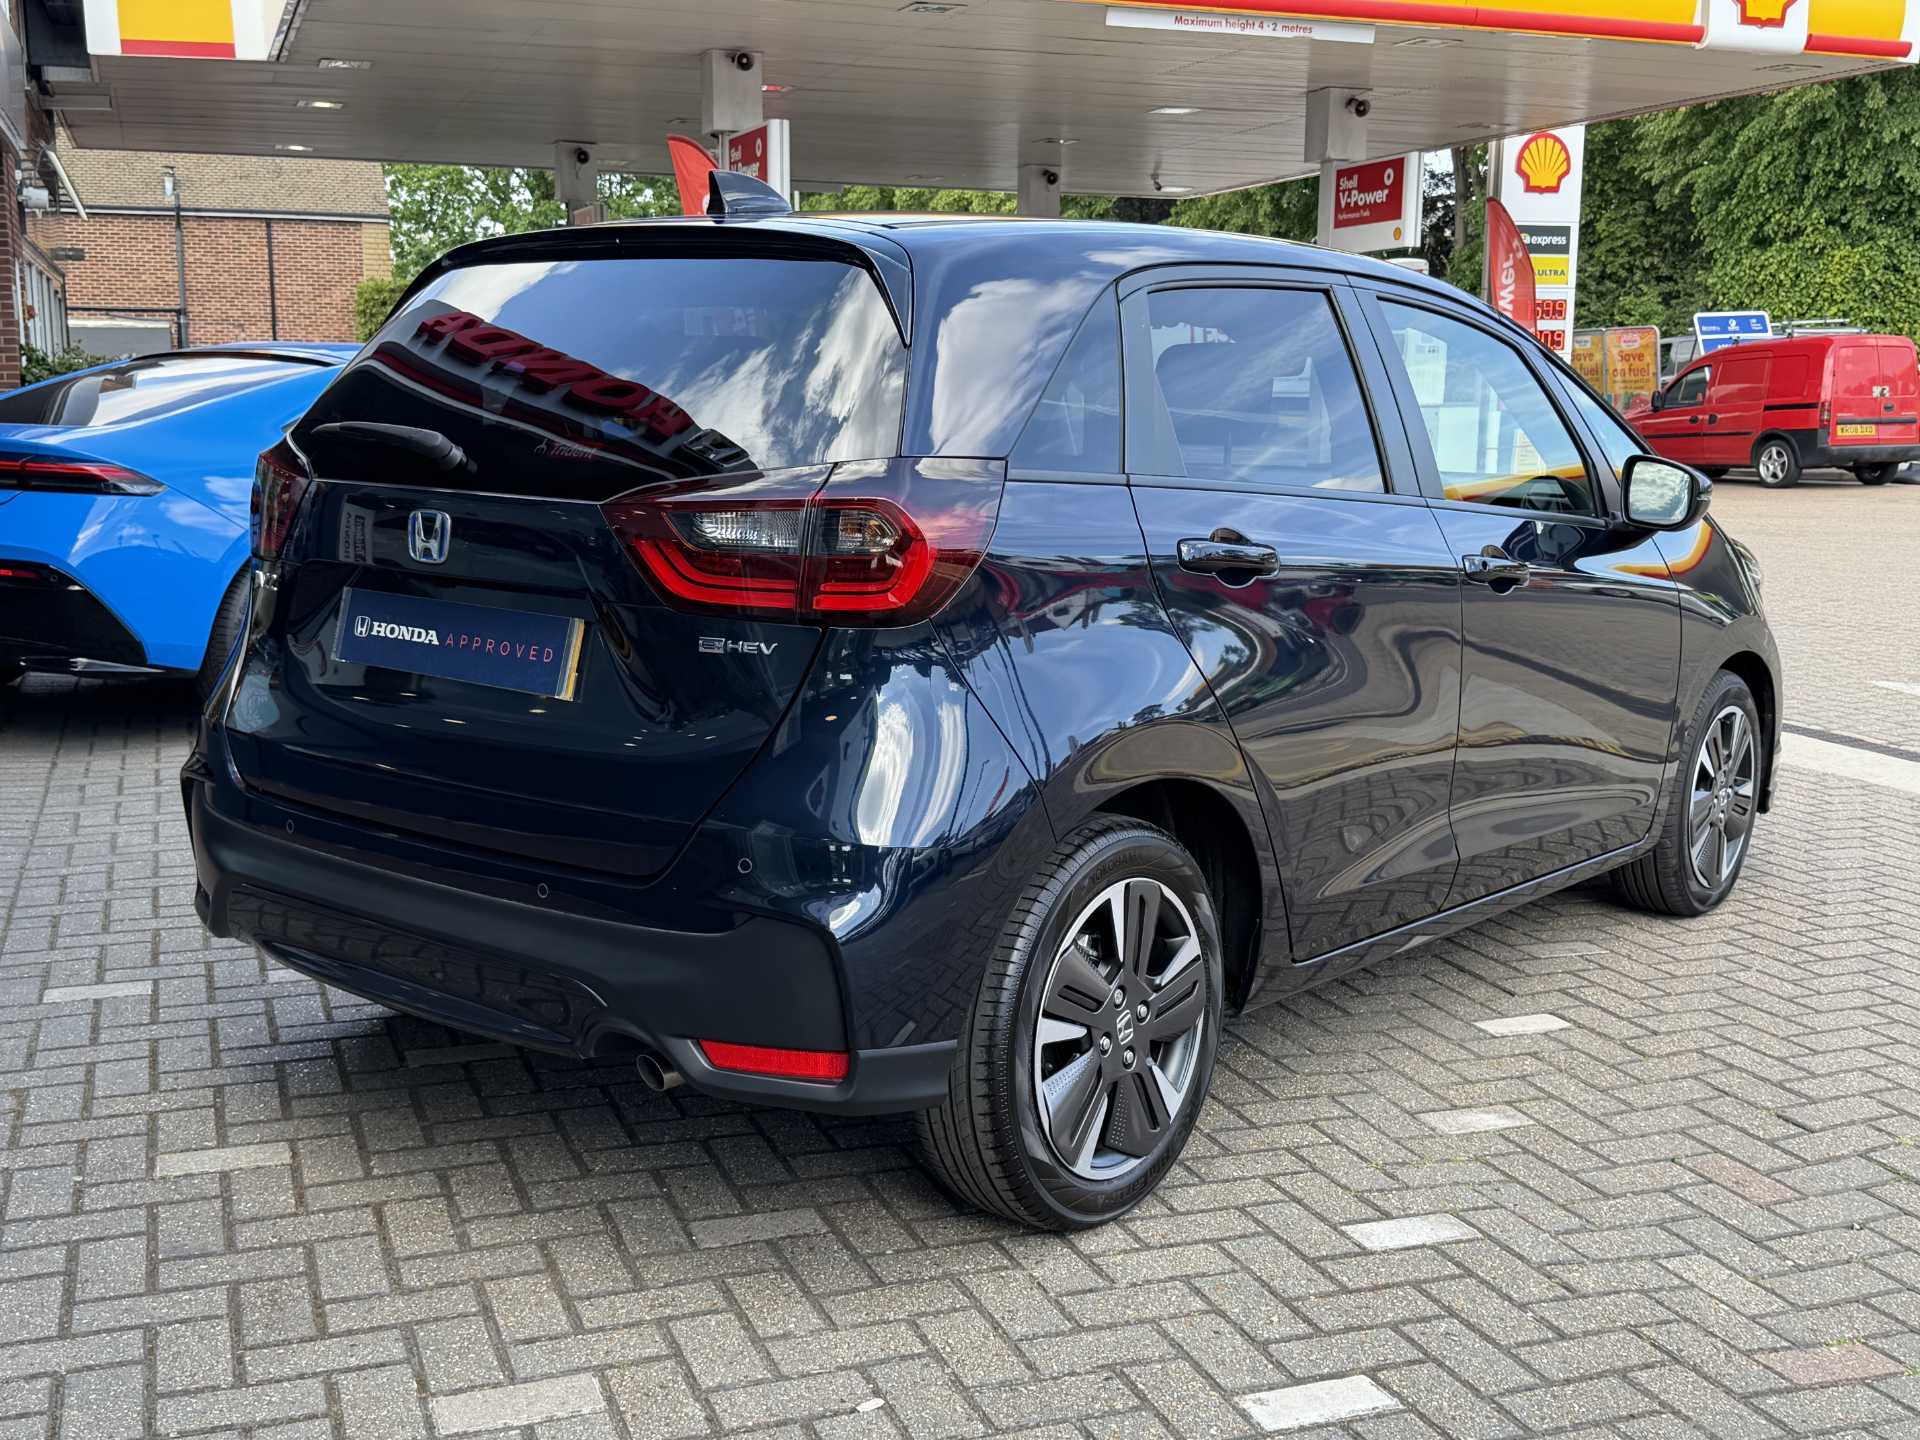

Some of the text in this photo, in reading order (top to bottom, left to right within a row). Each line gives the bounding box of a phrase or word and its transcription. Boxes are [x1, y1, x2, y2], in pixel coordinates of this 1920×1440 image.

[1174, 15, 1222, 29] Maximum
[1225, 18, 1255, 31] height
[1281, 23, 1313, 34] metres
[1339, 174, 1358, 190] Shell
[1339, 189, 1389, 209] V-Power
[1531, 235, 1567, 247] express
[1537, 269, 1566, 277] ULTRA
[1617, 349, 1645, 362] Save
[1628, 363, 1651, 377] fuel
[370, 621, 440, 646] HONDA
[445, 633, 554, 663] APPROVED
